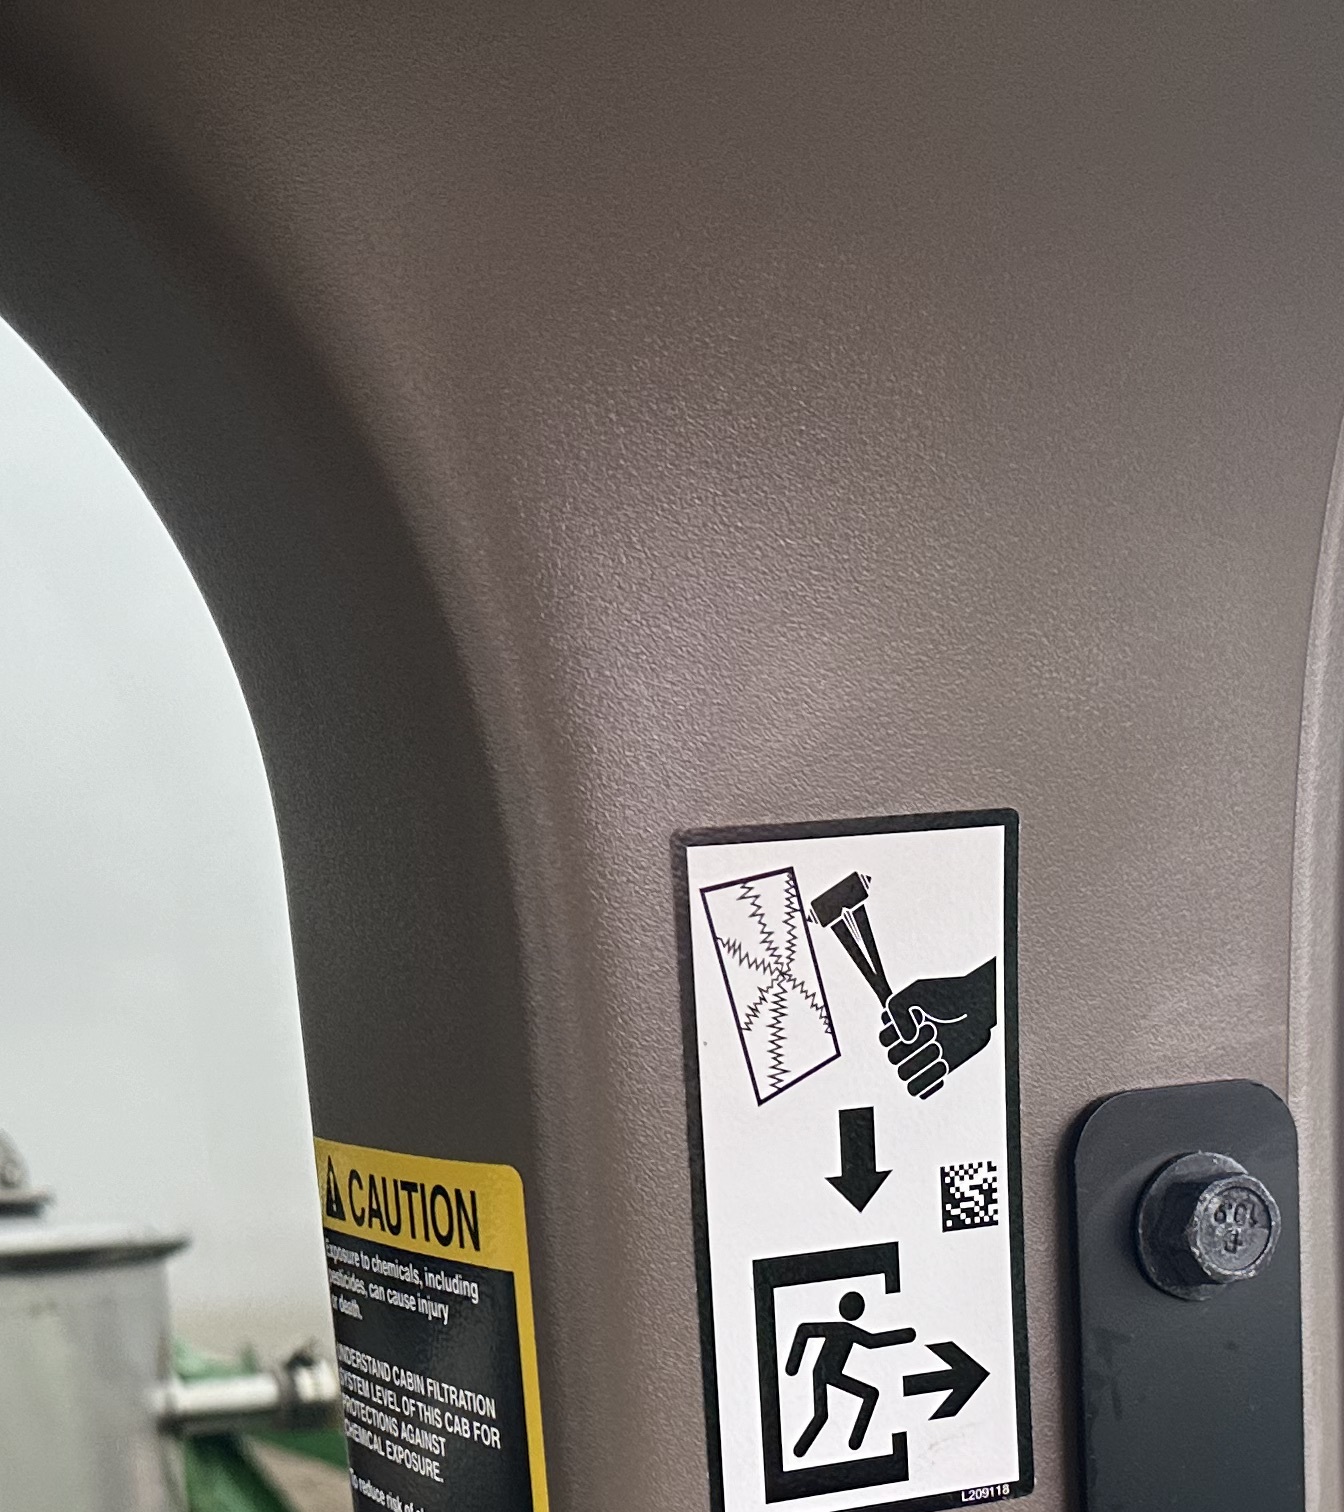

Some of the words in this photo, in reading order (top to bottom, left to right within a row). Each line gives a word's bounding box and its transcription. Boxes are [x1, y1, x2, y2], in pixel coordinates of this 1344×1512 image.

[348, 1169, 481, 1251] CAUTION
[325, 1240, 360, 1268] Exposure
[359, 1250, 371, 1271] to
[371, 1254, 424, 1289] chemicals,
[423, 1266, 479, 1305] including
[368, 1282, 386, 1302] can
[386, 1288, 417, 1311] cause
[417, 1297, 449, 1326] injury
[370, 1381, 401, 1413] LEVEL
[401, 1395, 416, 1418] OF
[416, 1400, 443, 1429] THIS
[444, 1411, 471, 1439] CAB
[472, 1420, 502, 1450] FOR
[391, 1365, 426, 1396] CABIN
[426, 1377, 497, 1419] FILTRATION
[341, 1392, 399, 1438] PROTECTIONS
[400, 1420, 447, 1458] AGAINST
[344, 1417, 385, 1457] CHEMICAL
[385, 1439, 445, 1483] EXPOSURE.
[358, 1477, 386, 1506] reduce
[961, 1483, 1010, 1502] L209118
